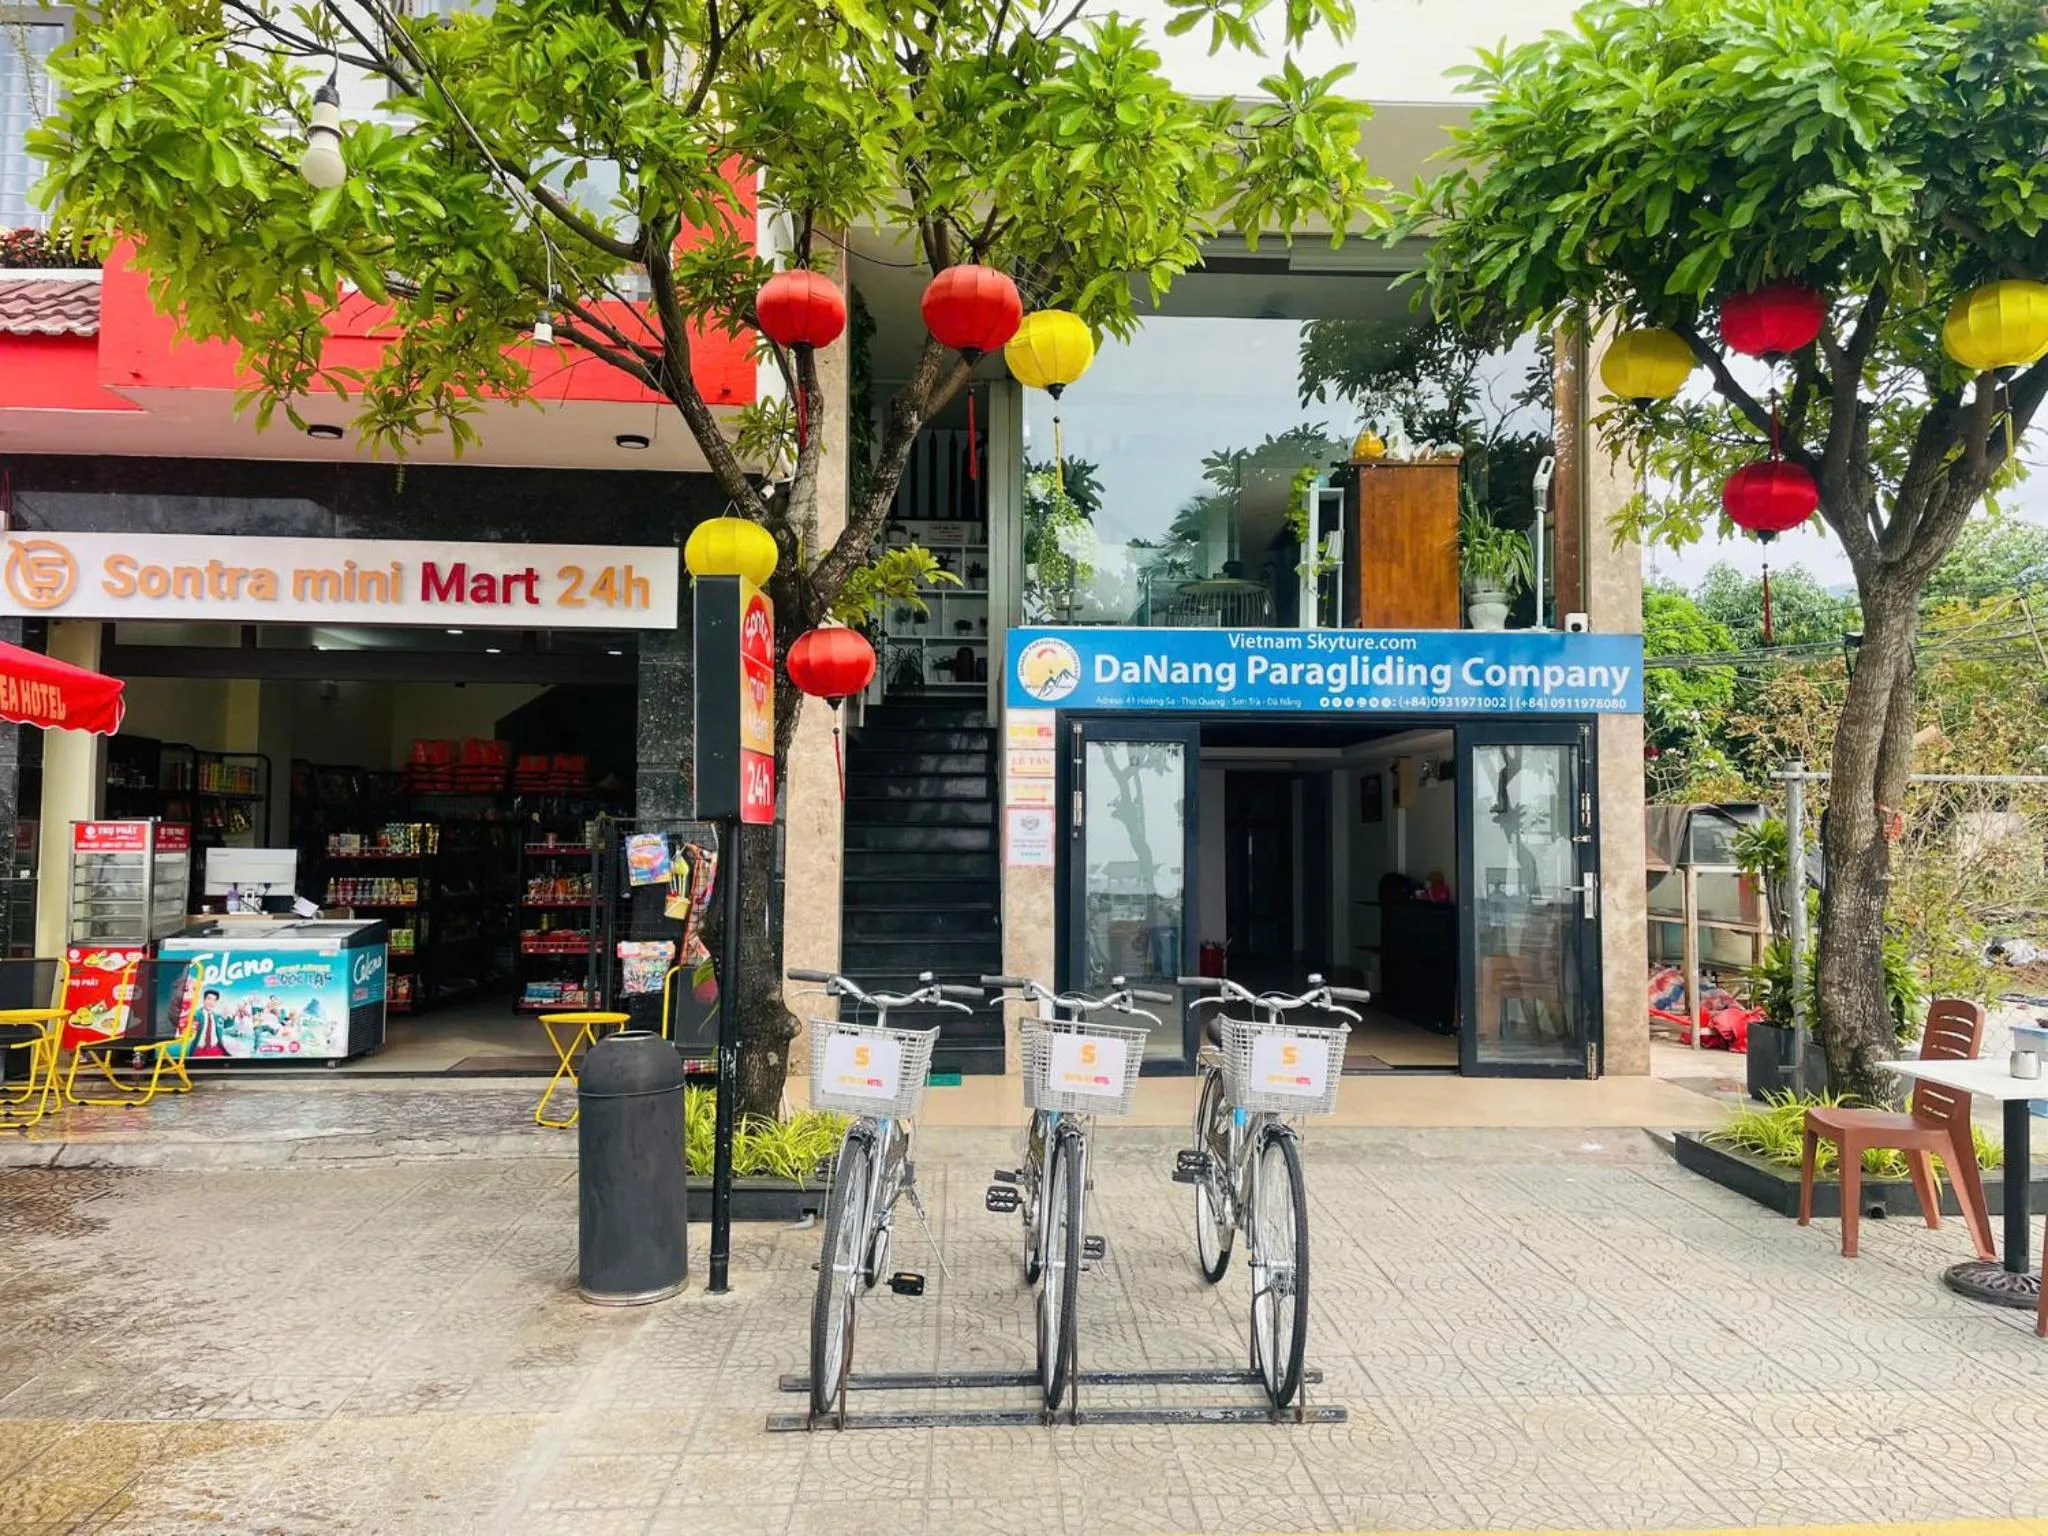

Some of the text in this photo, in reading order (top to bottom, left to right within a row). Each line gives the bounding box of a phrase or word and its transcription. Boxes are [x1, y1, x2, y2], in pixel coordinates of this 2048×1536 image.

[101, 554, 651, 610] Sontra mini Mart 24h
[1228, 633, 1417, 652] Vietnam Skyture.com
[1094, 654, 1631, 694] DaNang Paragliding Company
[20, 679, 67, 720] HOTEL
[747, 761, 770, 807] 24h
[855, 1045, 870, 1066] S
[1081, 1044, 1095, 1064] S
[1282, 1045, 1297, 1065] S
